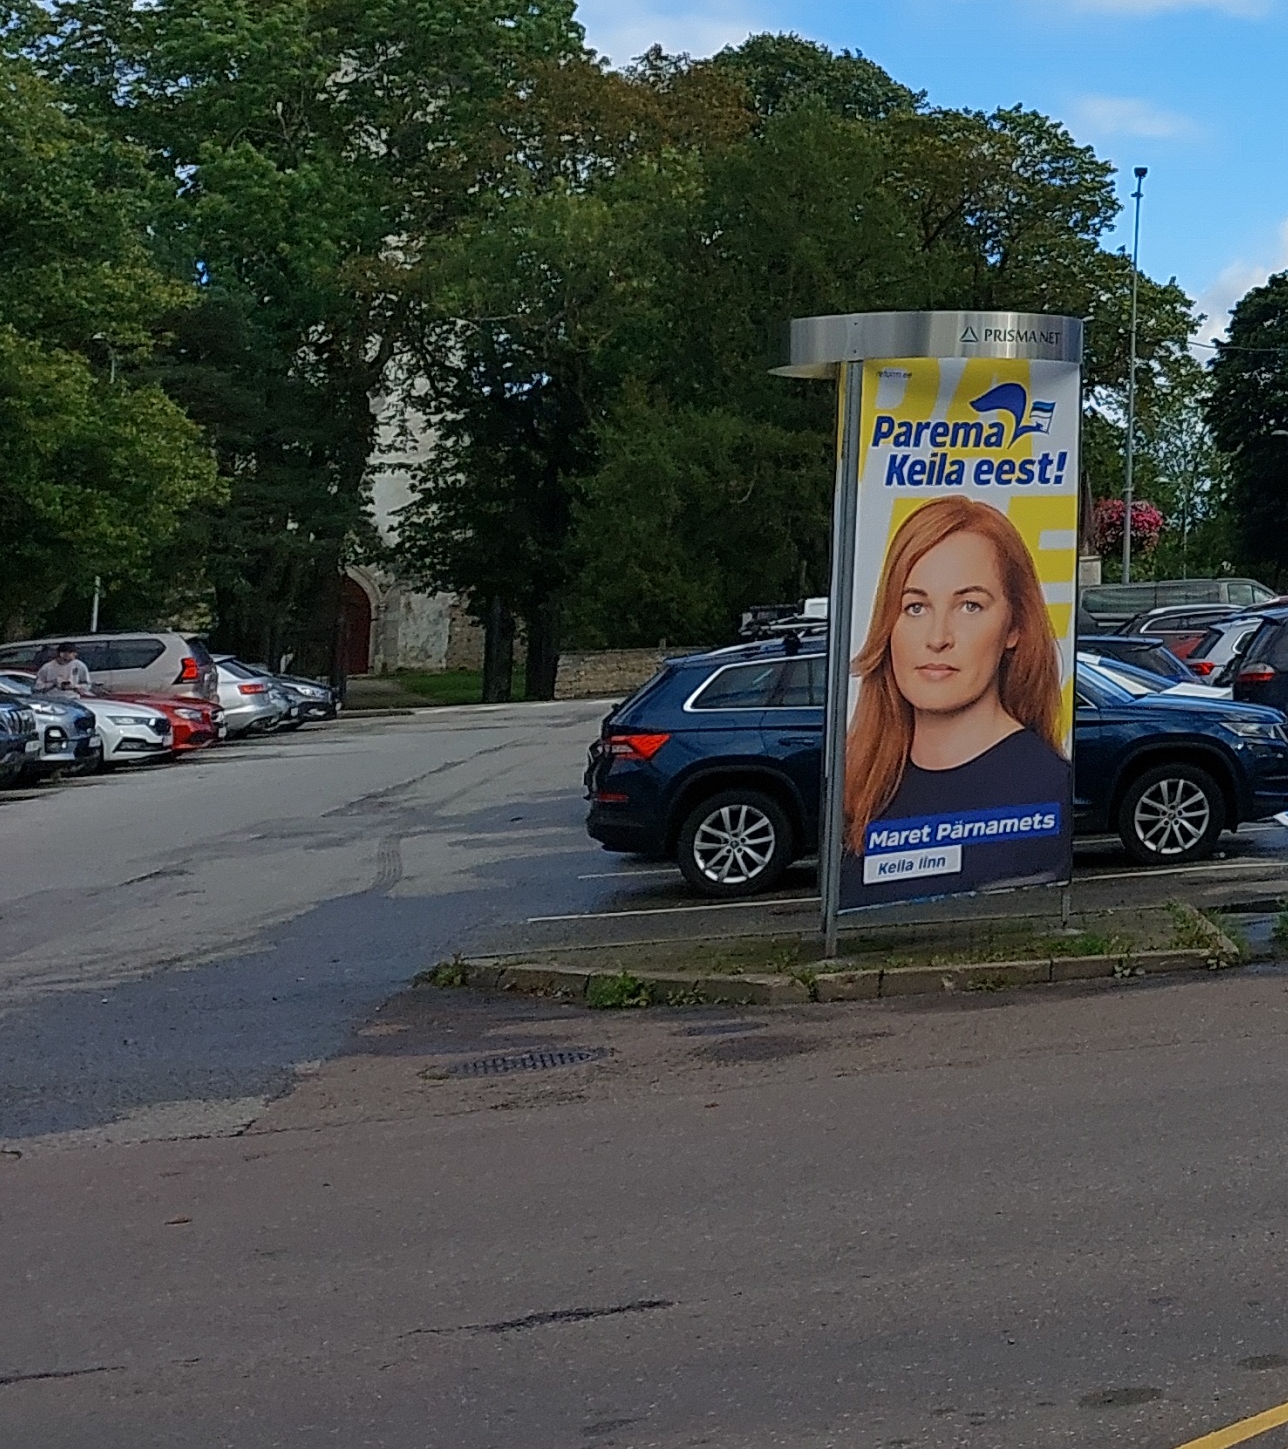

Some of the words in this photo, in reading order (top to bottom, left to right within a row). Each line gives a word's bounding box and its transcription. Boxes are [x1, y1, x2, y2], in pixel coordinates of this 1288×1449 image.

[984, 328, 1037, 343] PRISMA
[1039, 331, 1061, 345] NET
[871, 415, 1005, 449] Parema
[885, 451, 965, 487] Keila
[973, 451, 1068, 485] eest!
[868, 824, 931, 850] Maret
[936, 812, 1056, 841] Pärnamets
[877, 858, 914, 876] Keila
[918, 855, 946, 870] linn
